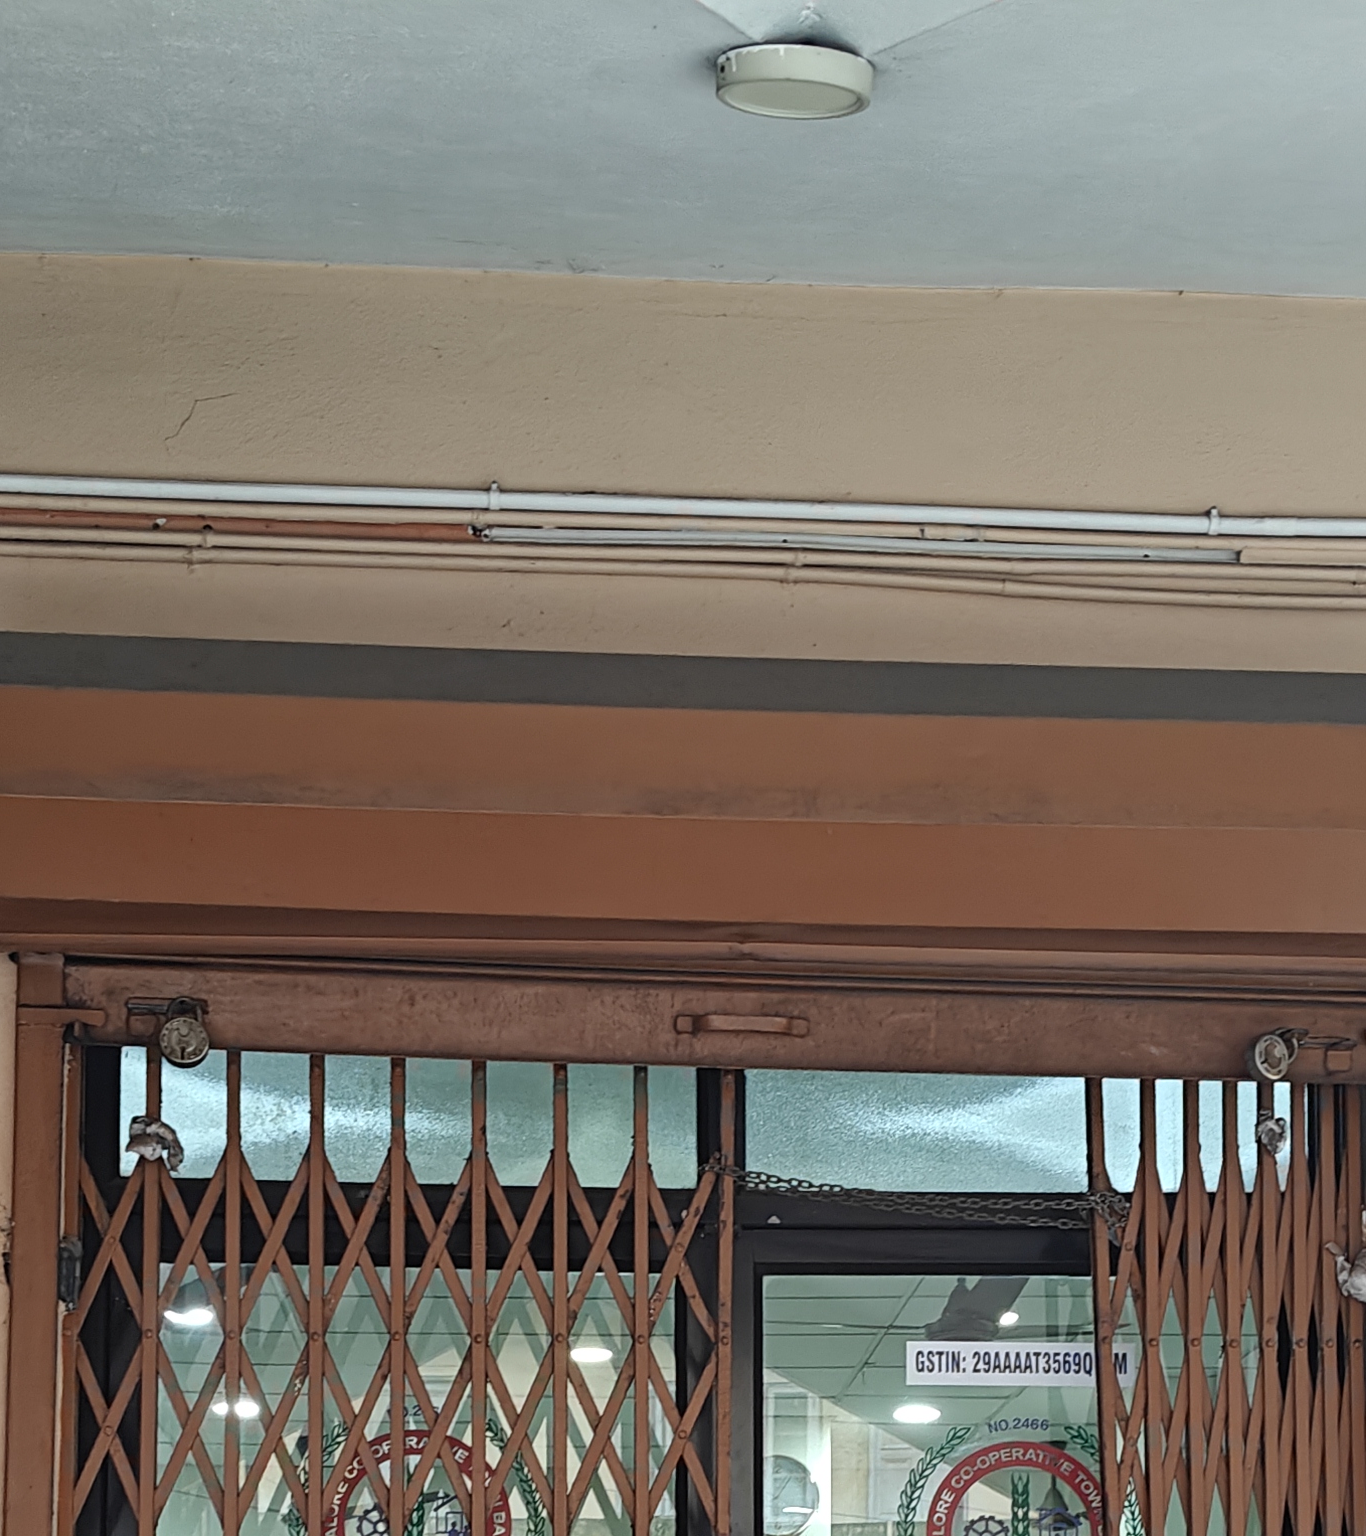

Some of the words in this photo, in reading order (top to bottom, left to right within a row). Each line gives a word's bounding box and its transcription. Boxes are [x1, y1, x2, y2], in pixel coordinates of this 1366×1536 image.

[915, 1350, 967, 1374] GSTIN:
[972, 1351, 1129, 1376] 29AAAAT3569QM
[987, 1417, 1050, 1434] NO.2466
